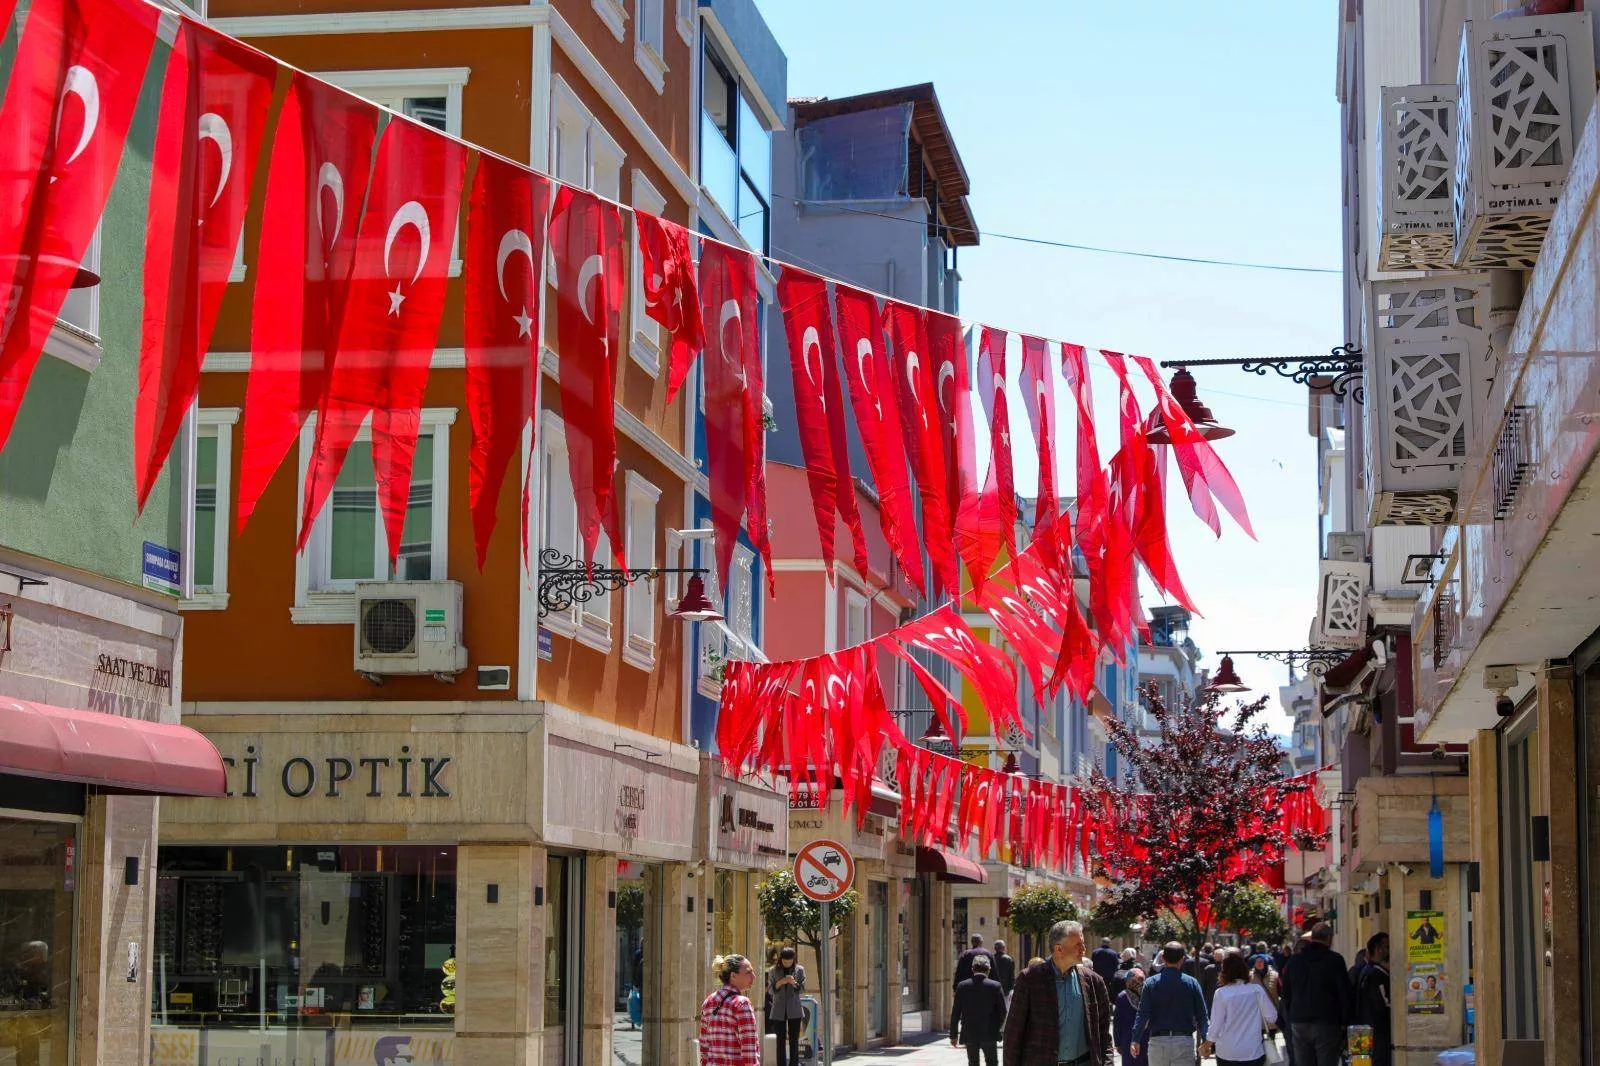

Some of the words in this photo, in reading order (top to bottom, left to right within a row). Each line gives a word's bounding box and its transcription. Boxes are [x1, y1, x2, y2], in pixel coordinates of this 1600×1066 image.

[98, 653, 128, 678] SAAT
[130, 661, 145, 682] VE
[144, 665, 171, 688] TAKI
[281, 745, 452, 798] OPTİK
